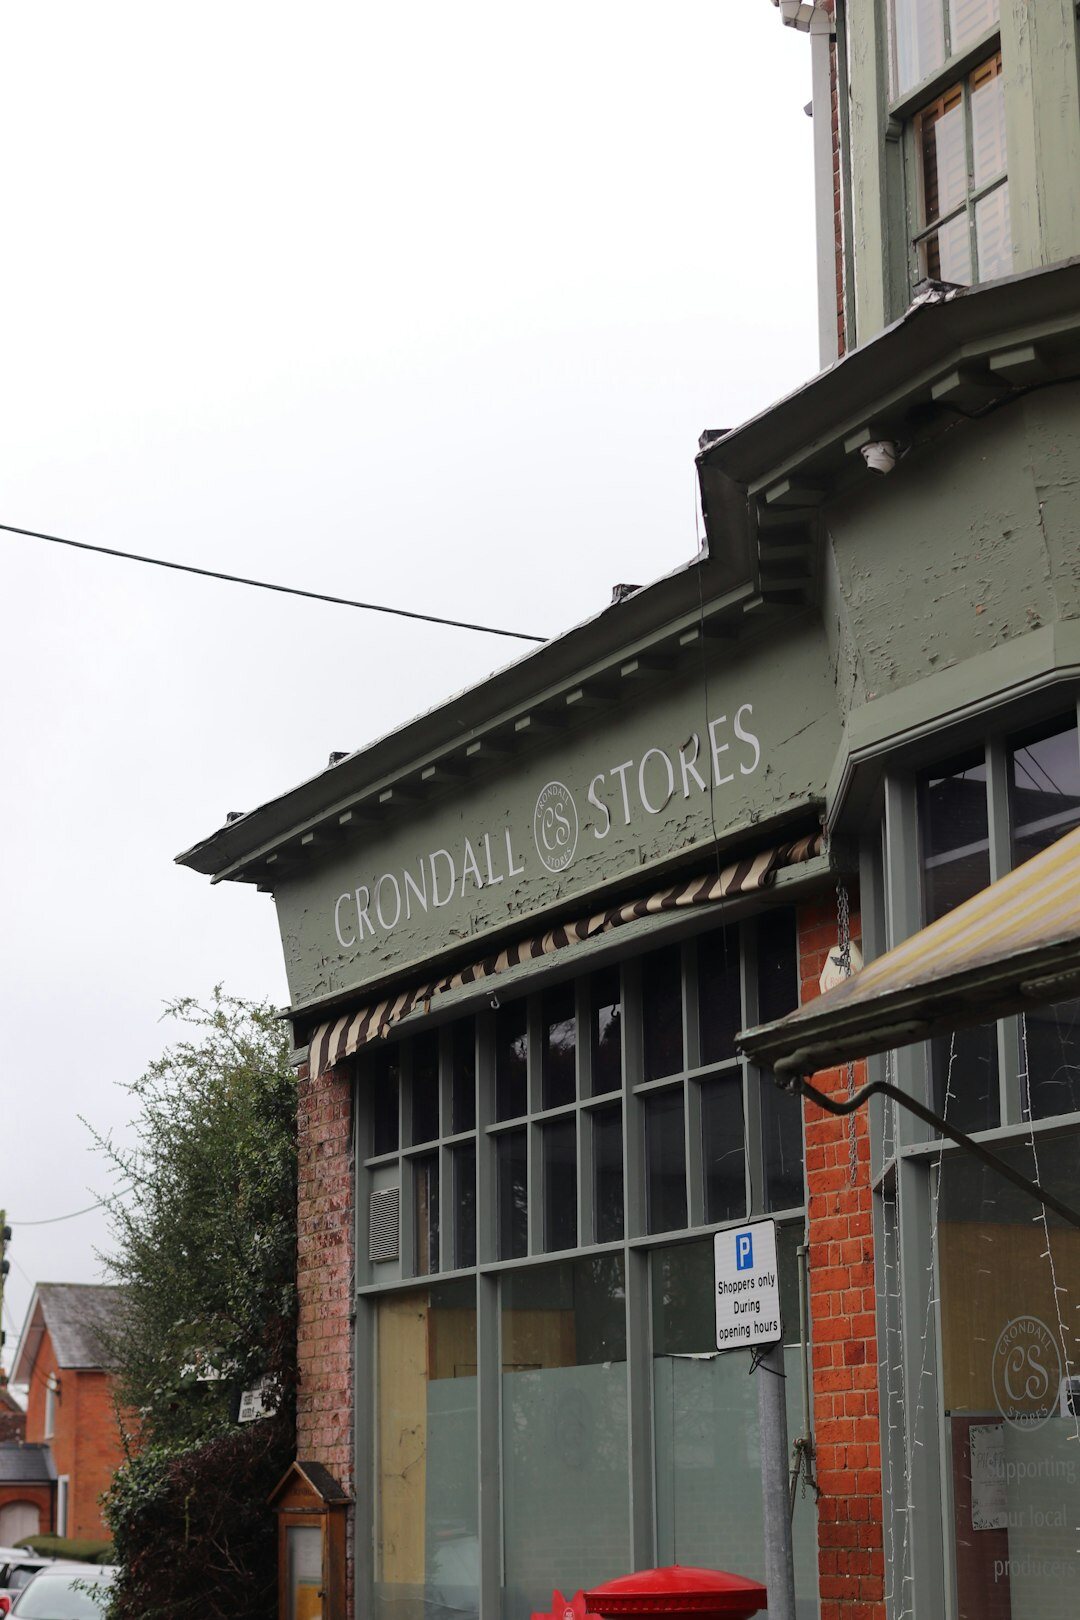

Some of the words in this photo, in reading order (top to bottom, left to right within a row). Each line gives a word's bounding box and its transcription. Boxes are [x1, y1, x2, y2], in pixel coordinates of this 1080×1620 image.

[537, 785, 569, 818] CRONDALL
[334, 826, 525, 948] CRONDALL
[587, 703, 762, 839] STORES
[542, 802, 571, 850] CS
[546, 847, 572, 868] STORES
[739, 1236, 751, 1268] P
[718, 1278, 755, 1295] Shoppers
[758, 1272, 775, 1288] only
[733, 1299, 761, 1315] During
[719, 1323, 751, 1341] opening
[753, 1320, 778, 1334] hours
[998, 1321, 1052, 1356] CRONDALL
[1004, 1344, 1049, 1401] CS
[1007, 1403, 1048, 1426] STORES
[1030, 1503, 1067, 1528] local
[994, 1552, 1077, 1583] producers
